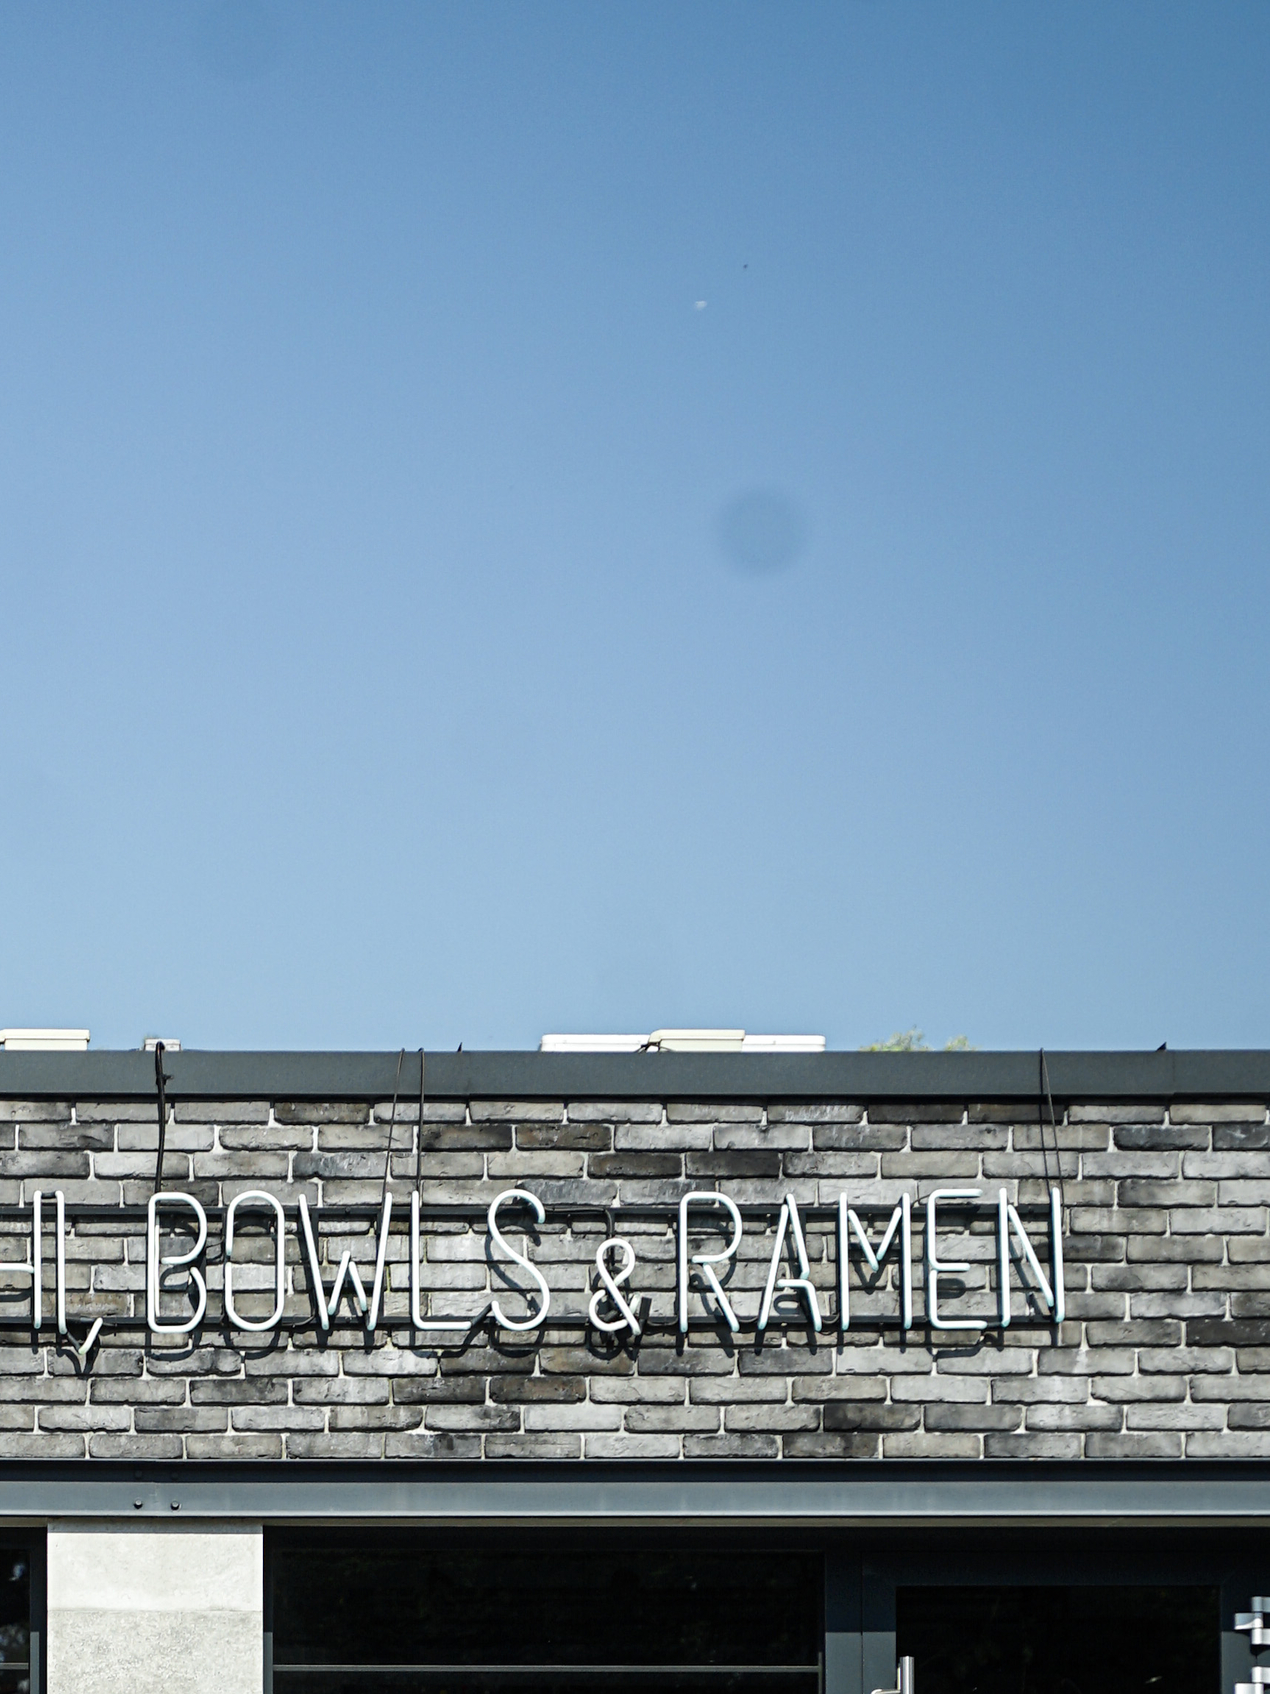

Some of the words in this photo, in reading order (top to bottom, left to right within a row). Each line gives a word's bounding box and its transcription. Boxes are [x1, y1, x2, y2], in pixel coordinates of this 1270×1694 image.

[147, 1188, 550, 1333] BOWLS
[589, 1237, 642, 1336] &
[678, 1187, 1064, 1333] RAMEN
